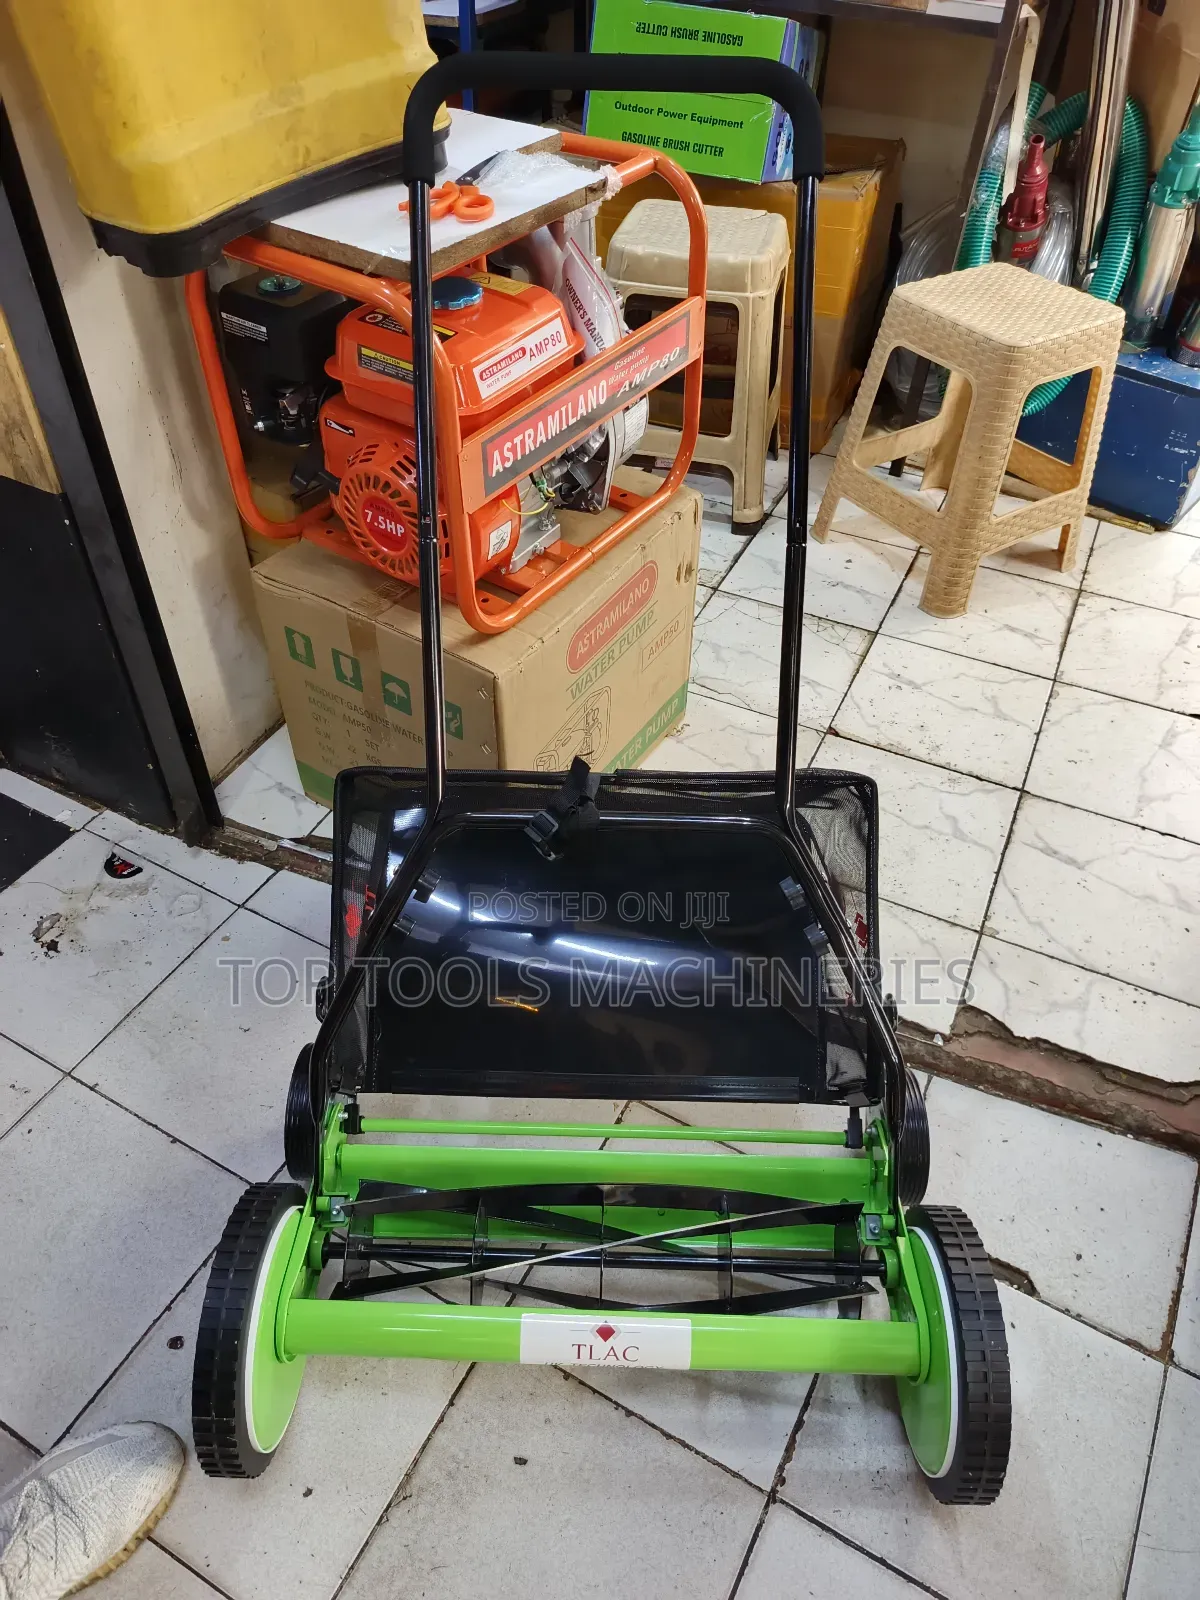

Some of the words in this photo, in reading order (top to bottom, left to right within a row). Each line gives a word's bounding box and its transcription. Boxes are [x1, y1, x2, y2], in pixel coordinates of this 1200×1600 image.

[635, 21, 669, 38] CUTTER
[670, 25, 700, 42] BRUSH
[702, 30, 744, 47] GASOLINE
[614, 100, 654, 116] Outdoor
[656, 107, 688, 121] Power
[690, 112, 744, 130] Equipment
[621, 131, 661, 147] GASOLINE
[662, 138, 691, 152] BRUSH
[692, 142, 724, 158] CUTTER
[565, 278, 588, 320] OWNER'S
[583, 317, 607, 352] MANUA
[529, 330, 562, 362] AMP80
[613, 346, 646, 371] Gasoline
[481, 349, 523, 380] ASTRAMILANO
[608, 366, 629, 386] Water
[617, 346, 680, 399] AMP80
[492, 379, 607, 478] ASTRAMILANO
[364, 509, 405, 537] 7.5HP
[575, 577, 650, 660] ASTRAMILANO
[647, 620, 680, 661] AMP50
[569, 647, 616, 701] WATER
[618, 609, 655, 657] PUMP
[342, 713, 372, 735] AMP50
[391, 722, 424, 746] WATER
[610, 738, 642, 772] ATER
[645, 697, 680, 744] PUMP
[364, 738, 380, 752] SET
[571, 1343, 640, 1363] TLAC
